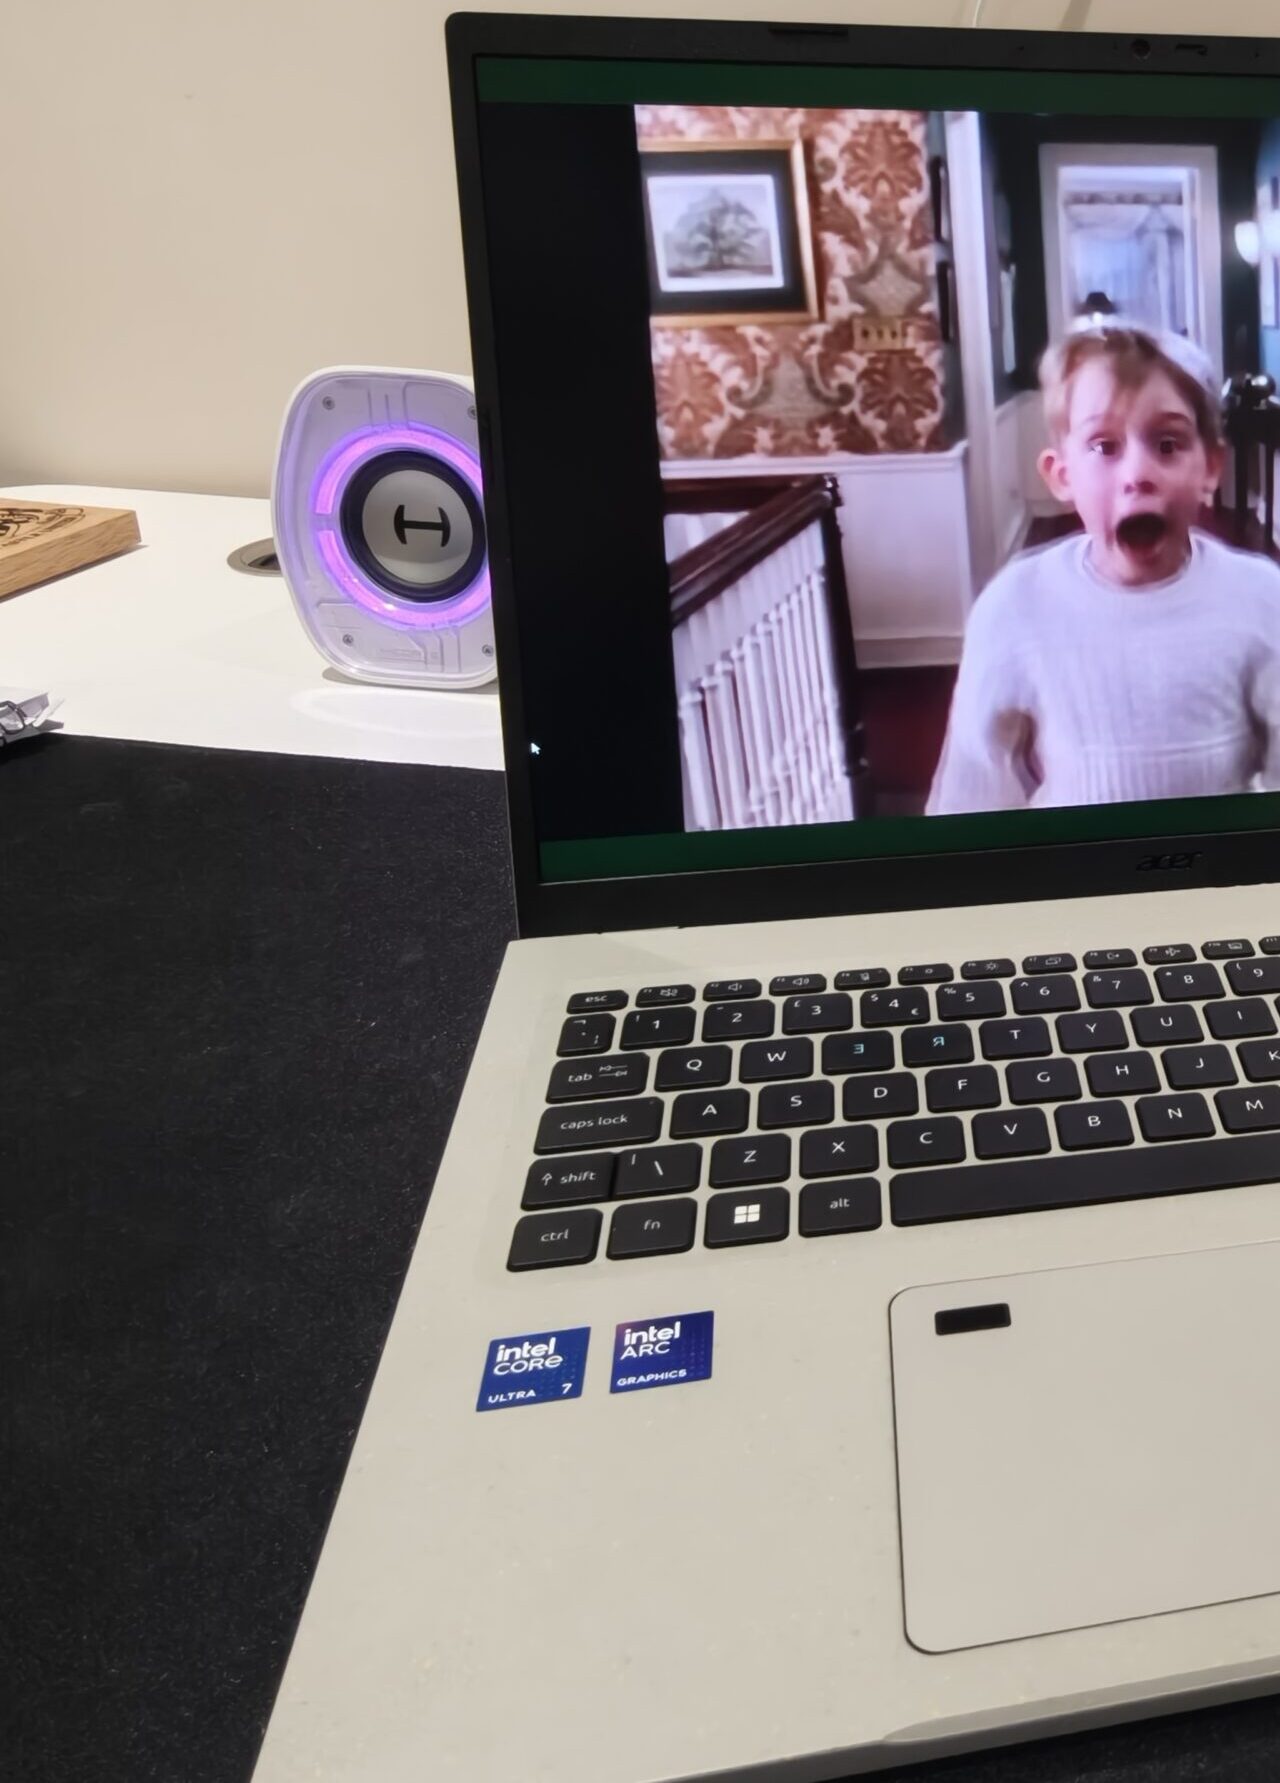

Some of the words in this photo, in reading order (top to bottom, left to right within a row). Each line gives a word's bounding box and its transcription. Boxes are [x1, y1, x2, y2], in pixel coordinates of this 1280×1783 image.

[1136, 850, 1203, 872] acer
[1252, 968, 1264, 978] 9
[1111, 979, 1121, 990] 7
[1039, 986, 1051, 996] 6
[585, 993, 608, 1003] esc
[888, 998, 900, 1008] 4
[965, 992, 976, 1003] 5
[811, 1004, 822, 1016] 3
[731, 1012, 743, 1023] 2
[1159, 1016, 1173, 1027] U
[652, 1019, 660, 1030] 1
[1085, 1022, 1097, 1034] Y
[1009, 1029, 1021, 1040] T
[766, 1050, 787, 1063] W
[685, 1058, 703, 1072] Q
[1195, 1057, 1205, 1069] J
[1115, 1064, 1130, 1076] H
[567, 1072, 593, 1083] tab
[1036, 1071, 1051, 1083] G
[957, 1078, 968, 1091] F
[873, 1086, 889, 1099] D
[790, 1094, 803, 1107] S
[1245, 1099, 1264, 1111] M
[702, 1103, 718, 1116] A
[1167, 1107, 1183, 1119] N
[560, 1119, 594, 1131] caps
[597, 1114, 628, 1126] lock
[1087, 1115, 1102, 1127] B
[1003, 1123, 1018, 1136] V
[919, 1131, 933, 1145] C
[831, 1141, 846, 1154] X
[743, 1149, 757, 1164] Z
[560, 1170, 596, 1184] shift
[829, 1197, 850, 1210] alt
[643, 1219, 661, 1231] fn
[540, 1228, 569, 1242] ctrl
[624, 1321, 681, 1346] intel
[496, 1337, 557, 1362] intel
[620, 1341, 671, 1360] ARC
[617, 1369, 687, 1387] GRAPHICS
[488, 1389, 536, 1404] ULTRA
[561, 1382, 573, 1395] 7
